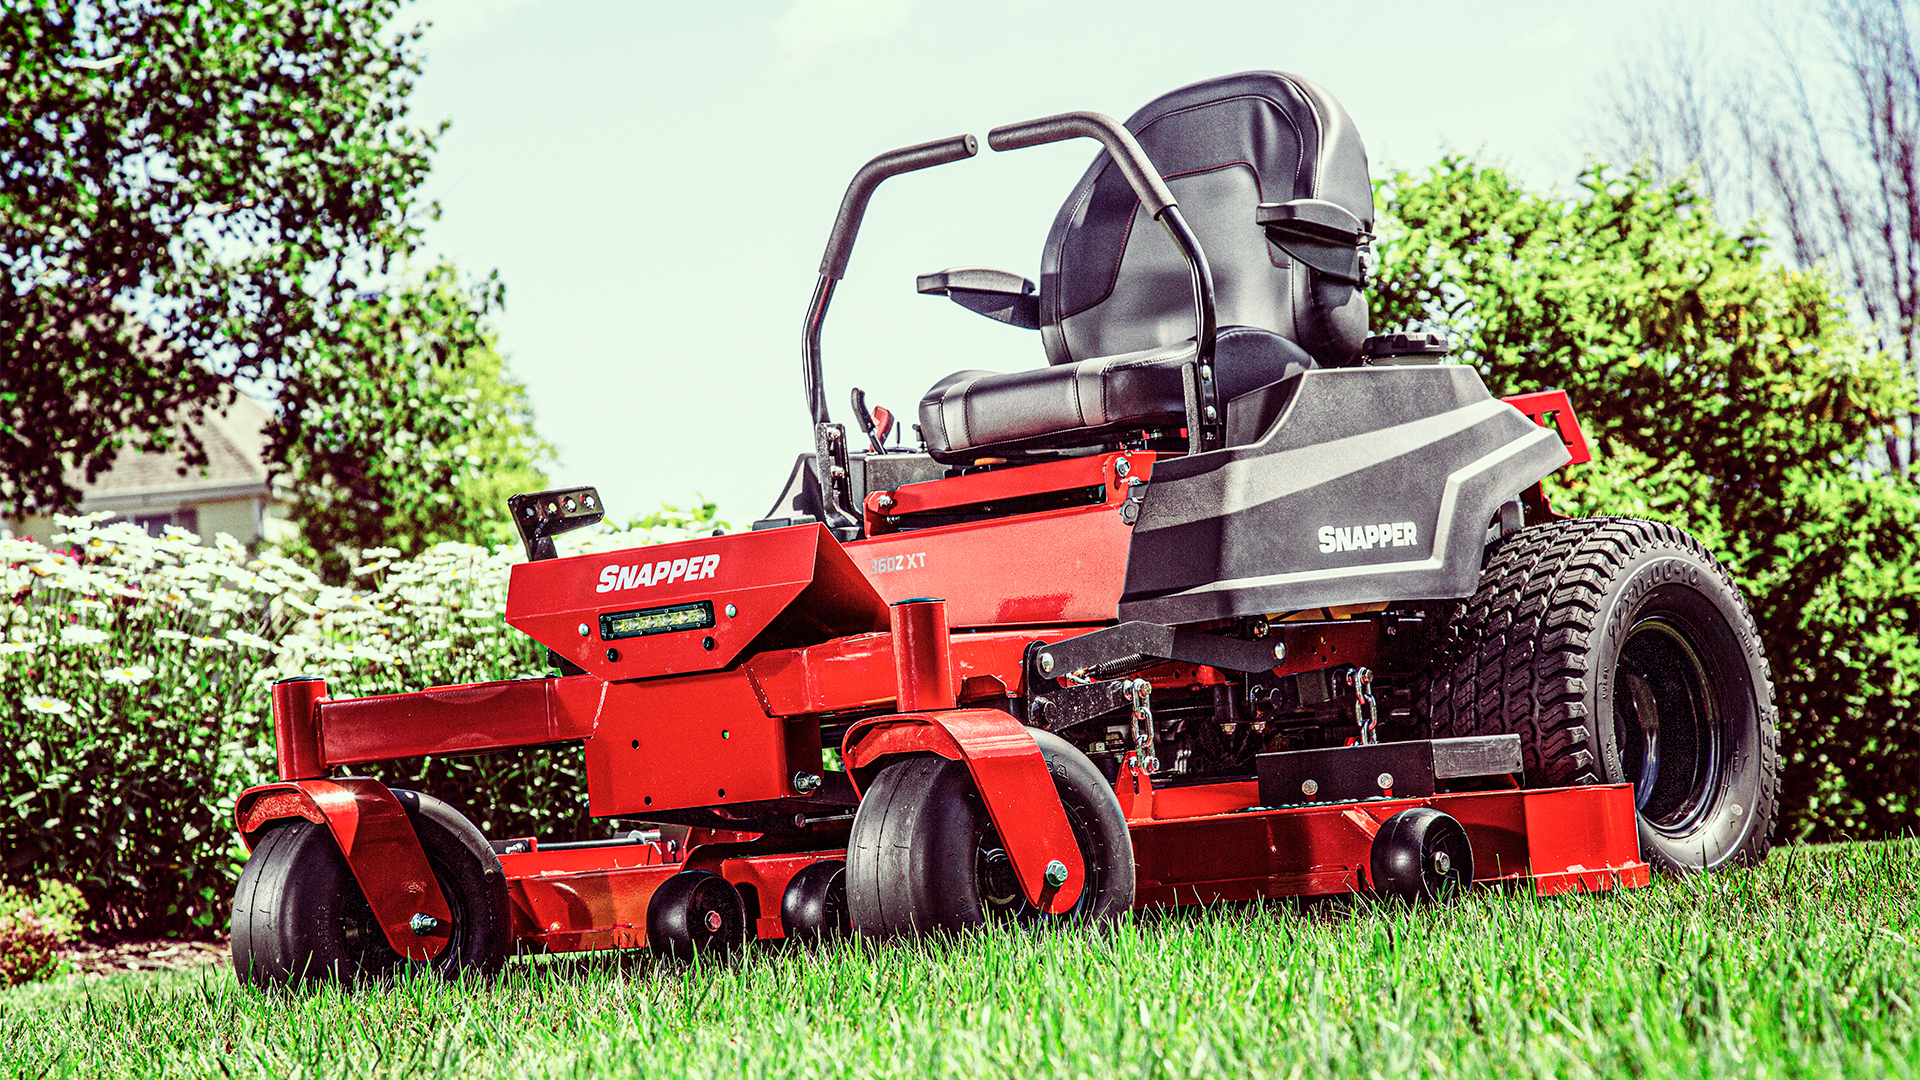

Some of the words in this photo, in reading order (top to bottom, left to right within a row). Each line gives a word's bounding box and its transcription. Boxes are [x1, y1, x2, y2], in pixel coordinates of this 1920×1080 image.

[1318, 521, 1418, 554] SNAPPER
[596, 553, 720, 594] SNAPPER
[1756, 705, 1774, 821] KENDA
